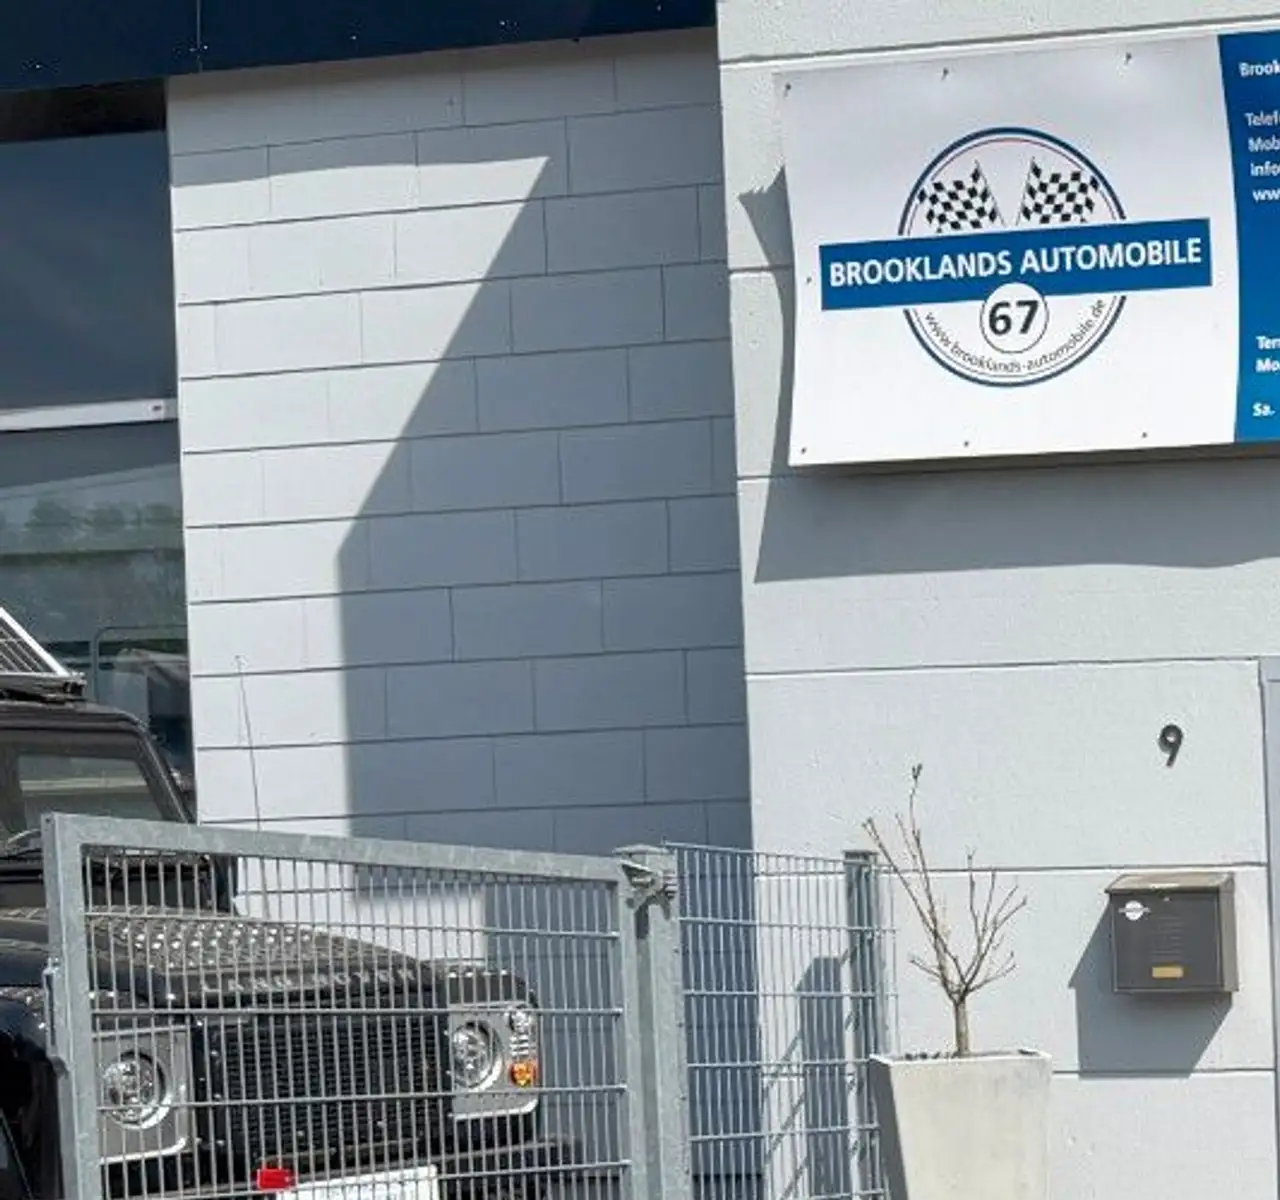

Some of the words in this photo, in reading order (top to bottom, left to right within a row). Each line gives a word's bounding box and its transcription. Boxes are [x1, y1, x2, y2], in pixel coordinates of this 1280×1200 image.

[829, 245, 1012, 288] BROOKLANDS
[1019, 236, 1202, 276] AUTOMOBILE
[989, 300, 1039, 335] 67
[1253, 402, 1276, 417] Sa.
[1158, 724, 1183, 767] 9
